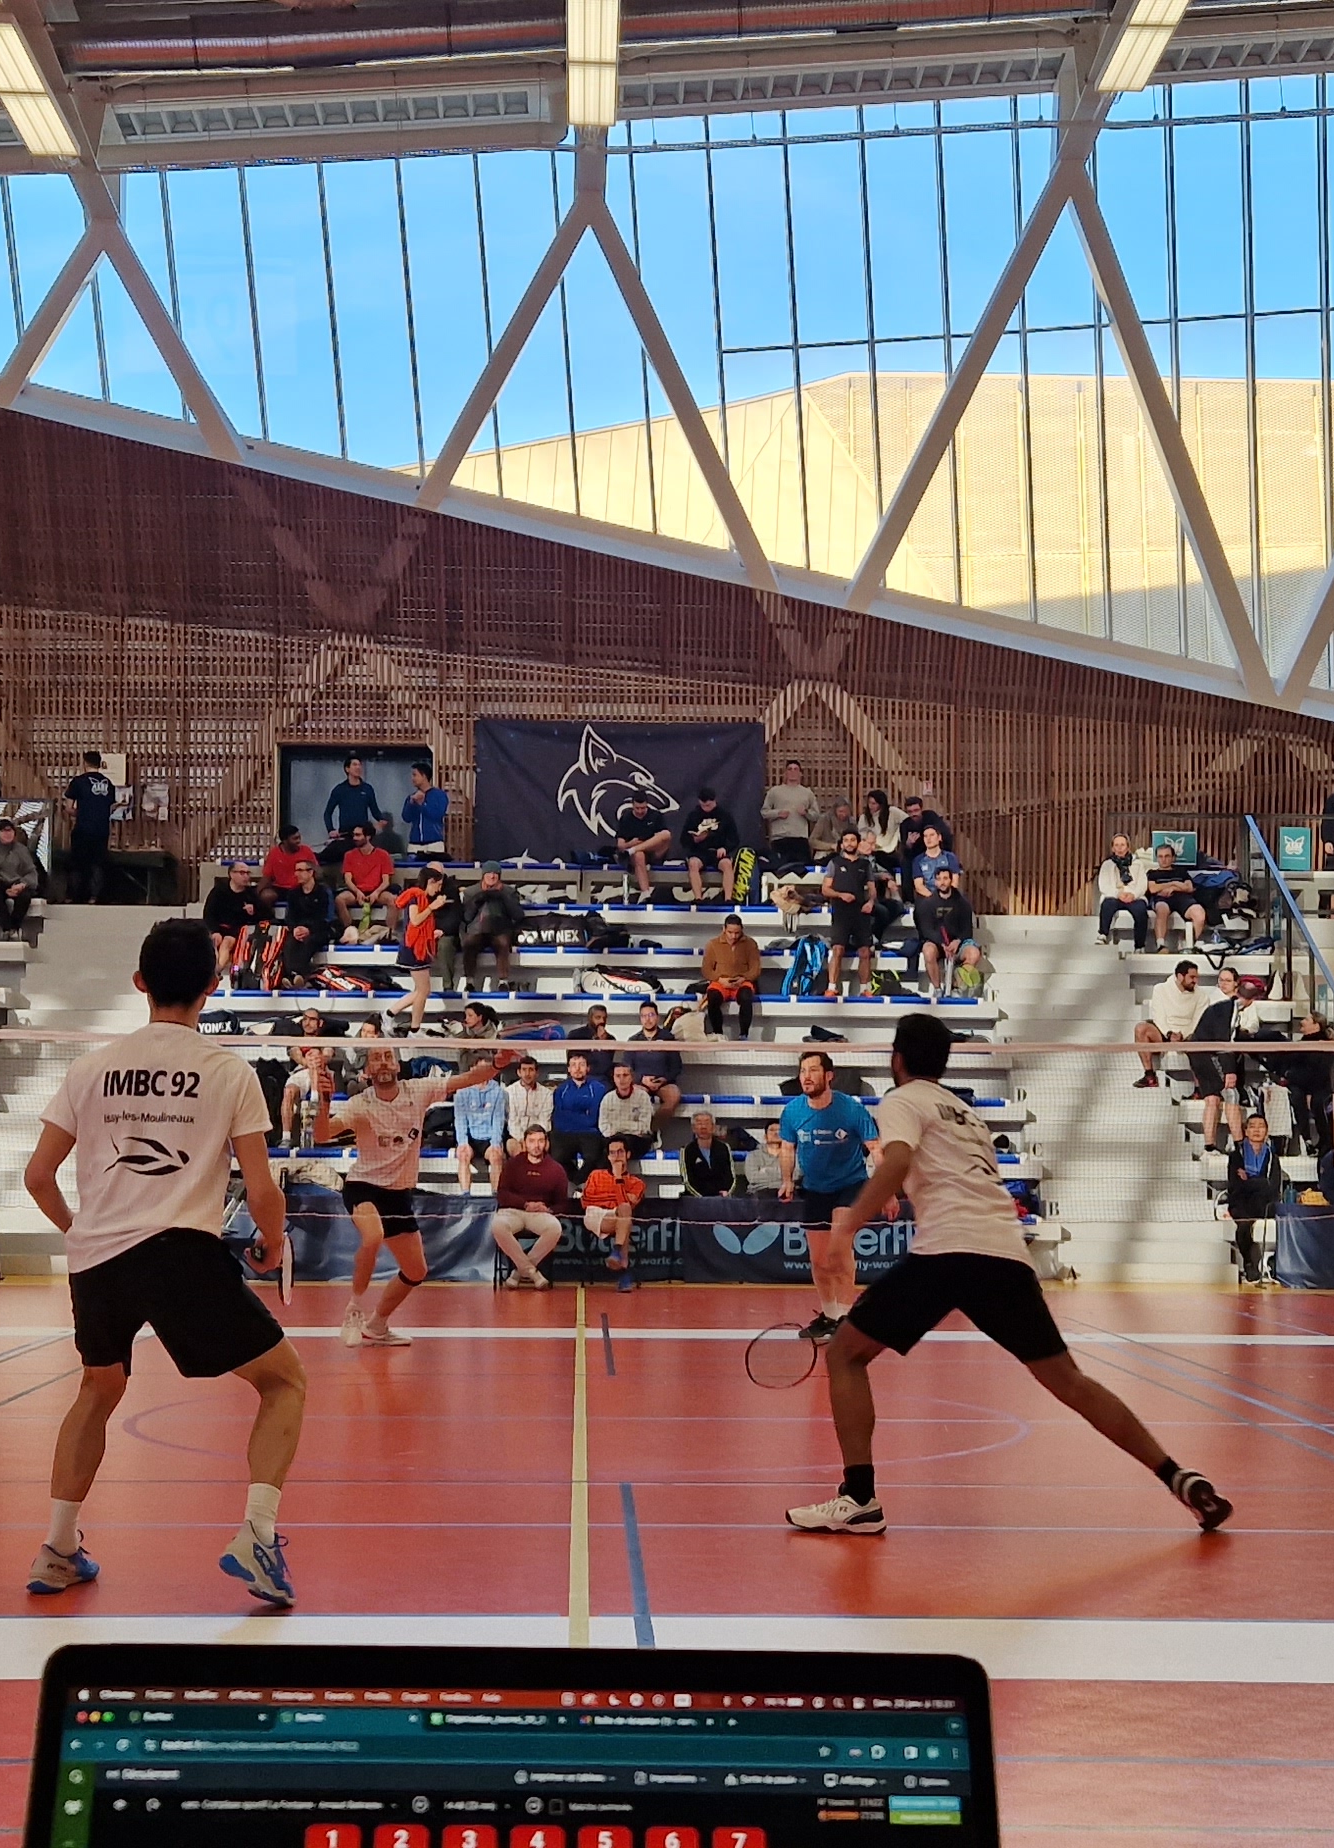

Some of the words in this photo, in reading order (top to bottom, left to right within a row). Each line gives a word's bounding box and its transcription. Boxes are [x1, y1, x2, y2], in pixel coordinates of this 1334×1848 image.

[103, 1069, 168, 1098] IMBC
[170, 1070, 201, 1099] 92
[326, 1829, 339, 1848] 1
[392, 1829, 409, 1848] 2
[461, 1830, 478, 1848] 3
[529, 1831, 546, 1848] 4
[597, 1832, 614, 1848] 5
[664, 1832, 681, 1848] 6
[731, 1832, 748, 1848] 7
